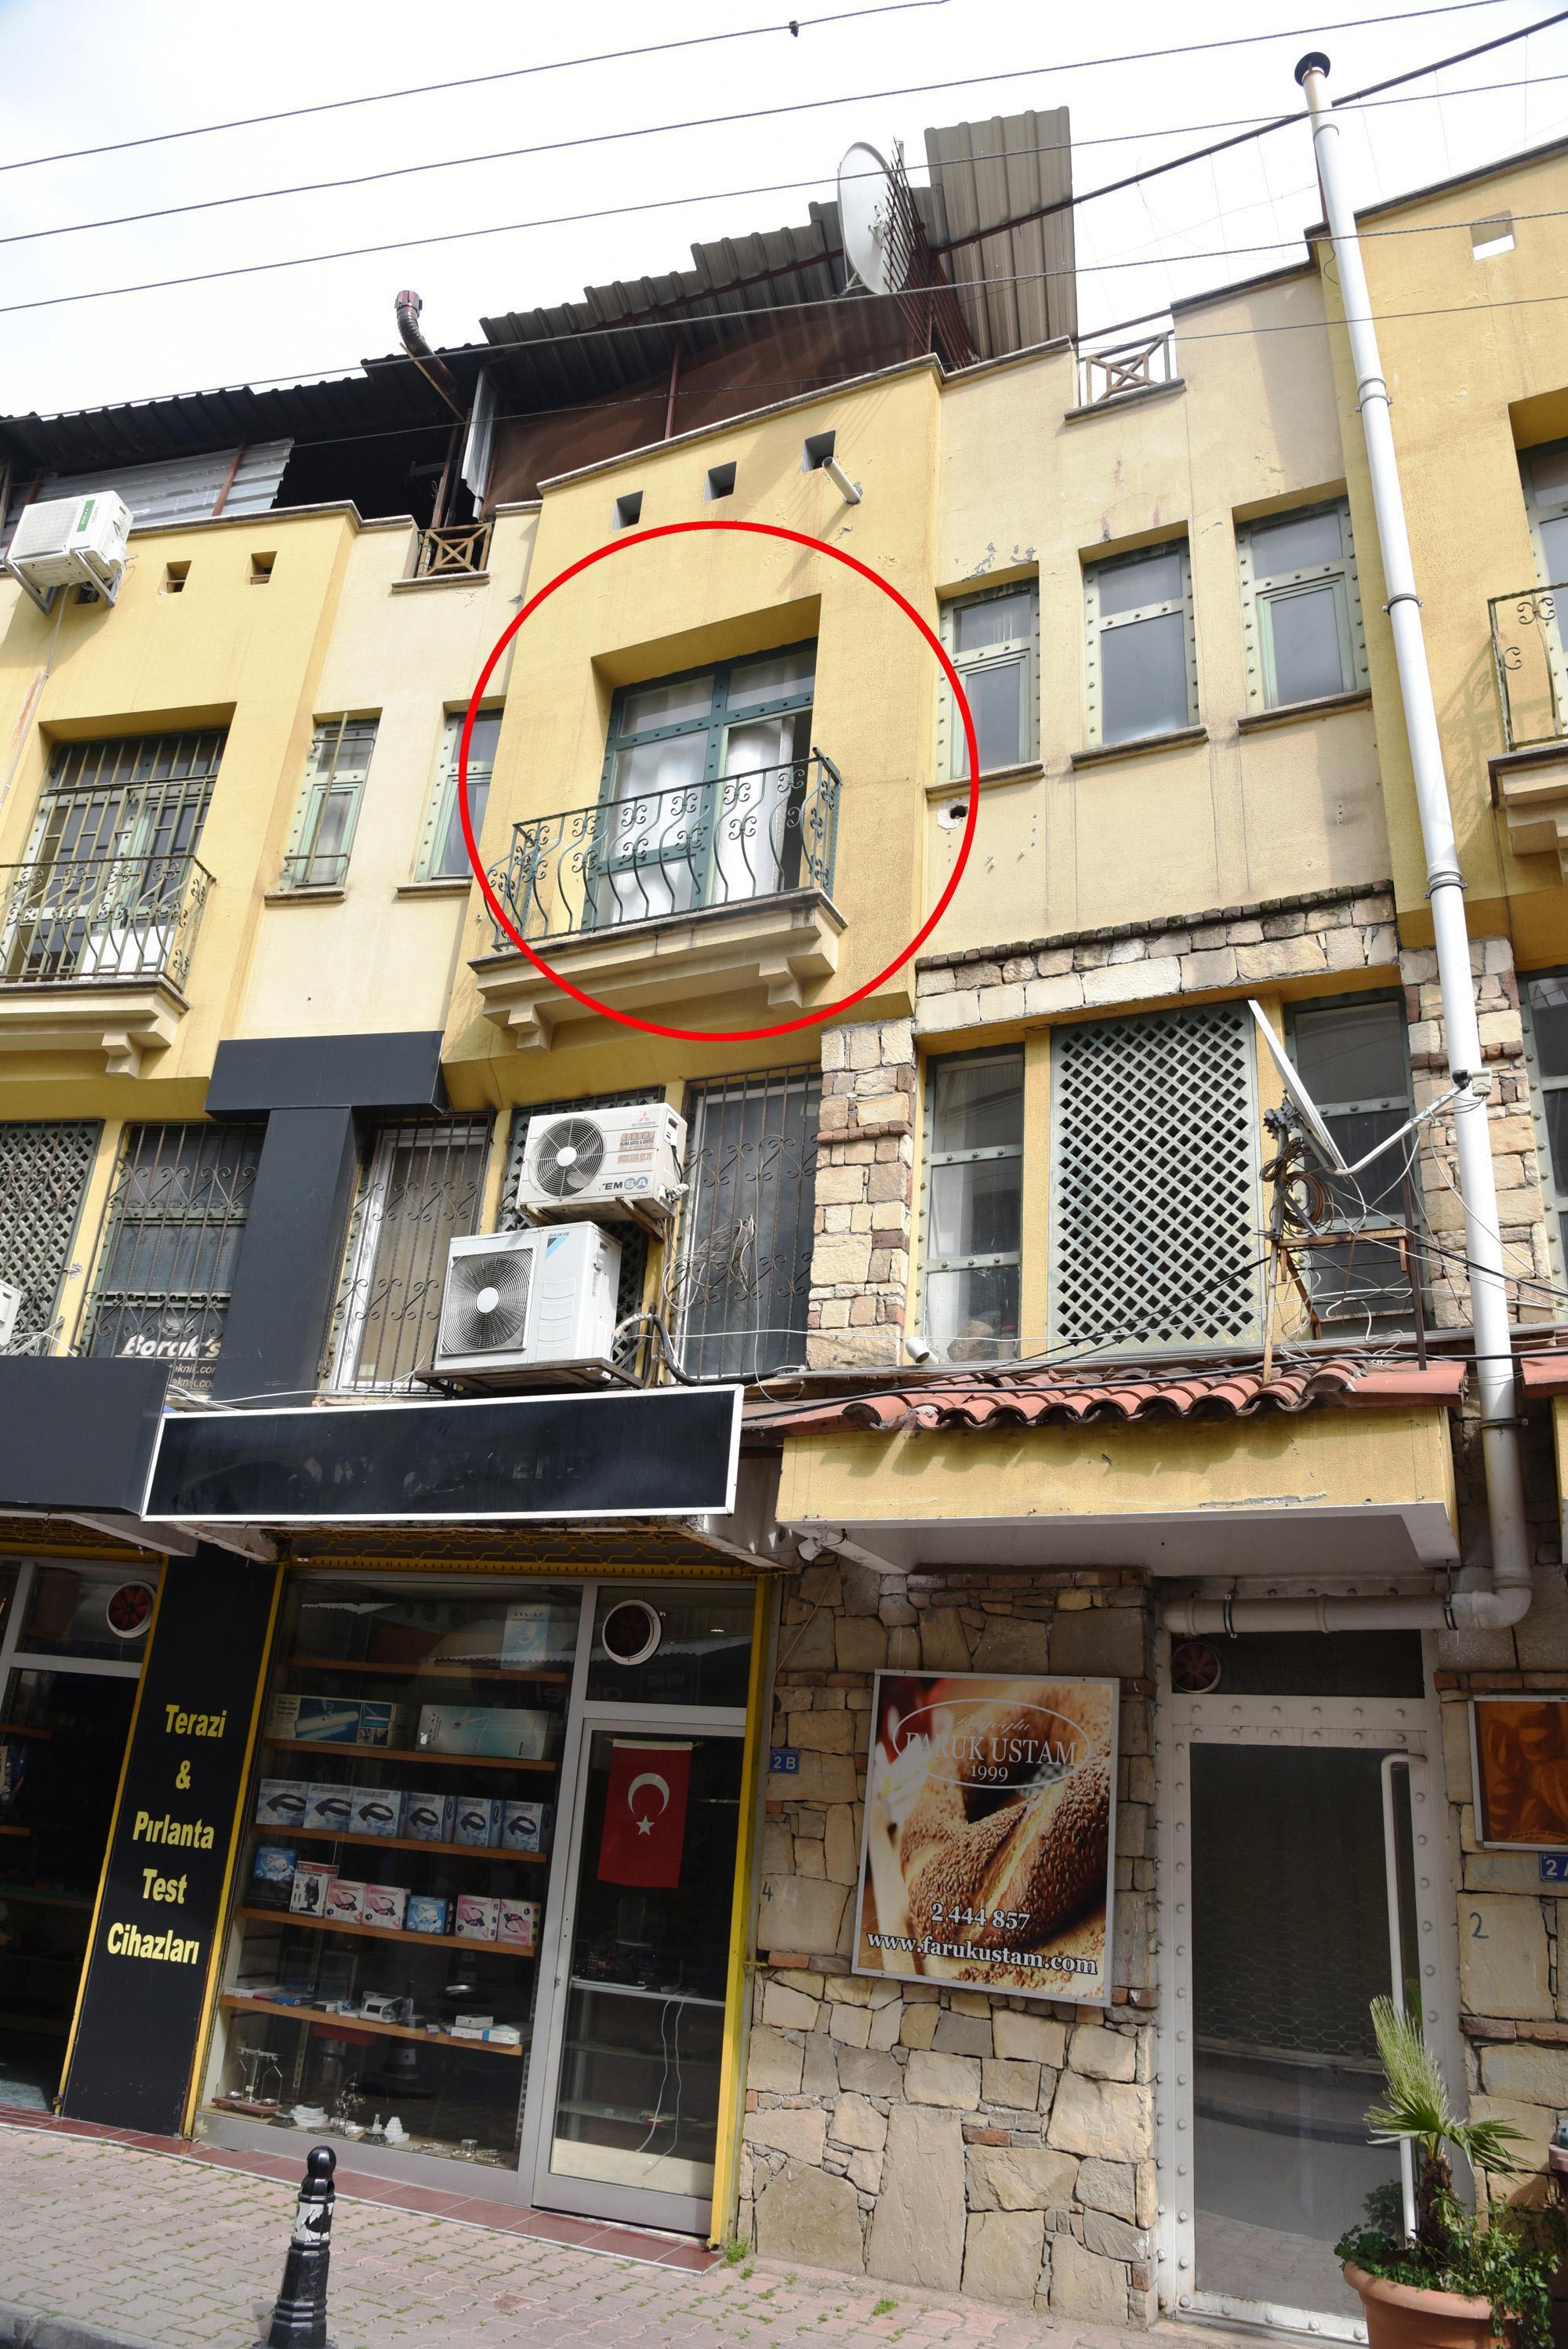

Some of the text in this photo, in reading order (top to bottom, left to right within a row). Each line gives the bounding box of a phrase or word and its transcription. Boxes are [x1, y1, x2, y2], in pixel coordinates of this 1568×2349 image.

[602, 1177, 648, 1191] EMSA
[165, 1704, 227, 1737] Terazi
[773, 1755, 797, 1770] 2 B
[991, 1737, 1078, 1766] USTAM
[176, 1760, 192, 1789] &
[970, 1765, 1008, 1782] 1999
[132, 1810, 215, 1850] Pırlanta
[1545, 1859, 1558, 1876] 2
[142, 1868, 188, 1904] Test
[762, 1881, 774, 1902] 4
[931, 1901, 1031, 1932] 2 444 857
[1469, 1912, 1490, 1940] 2
[107, 1922, 200, 1965] Cihazları
[866, 1932, 1098, 1975] www.farukustam.com
